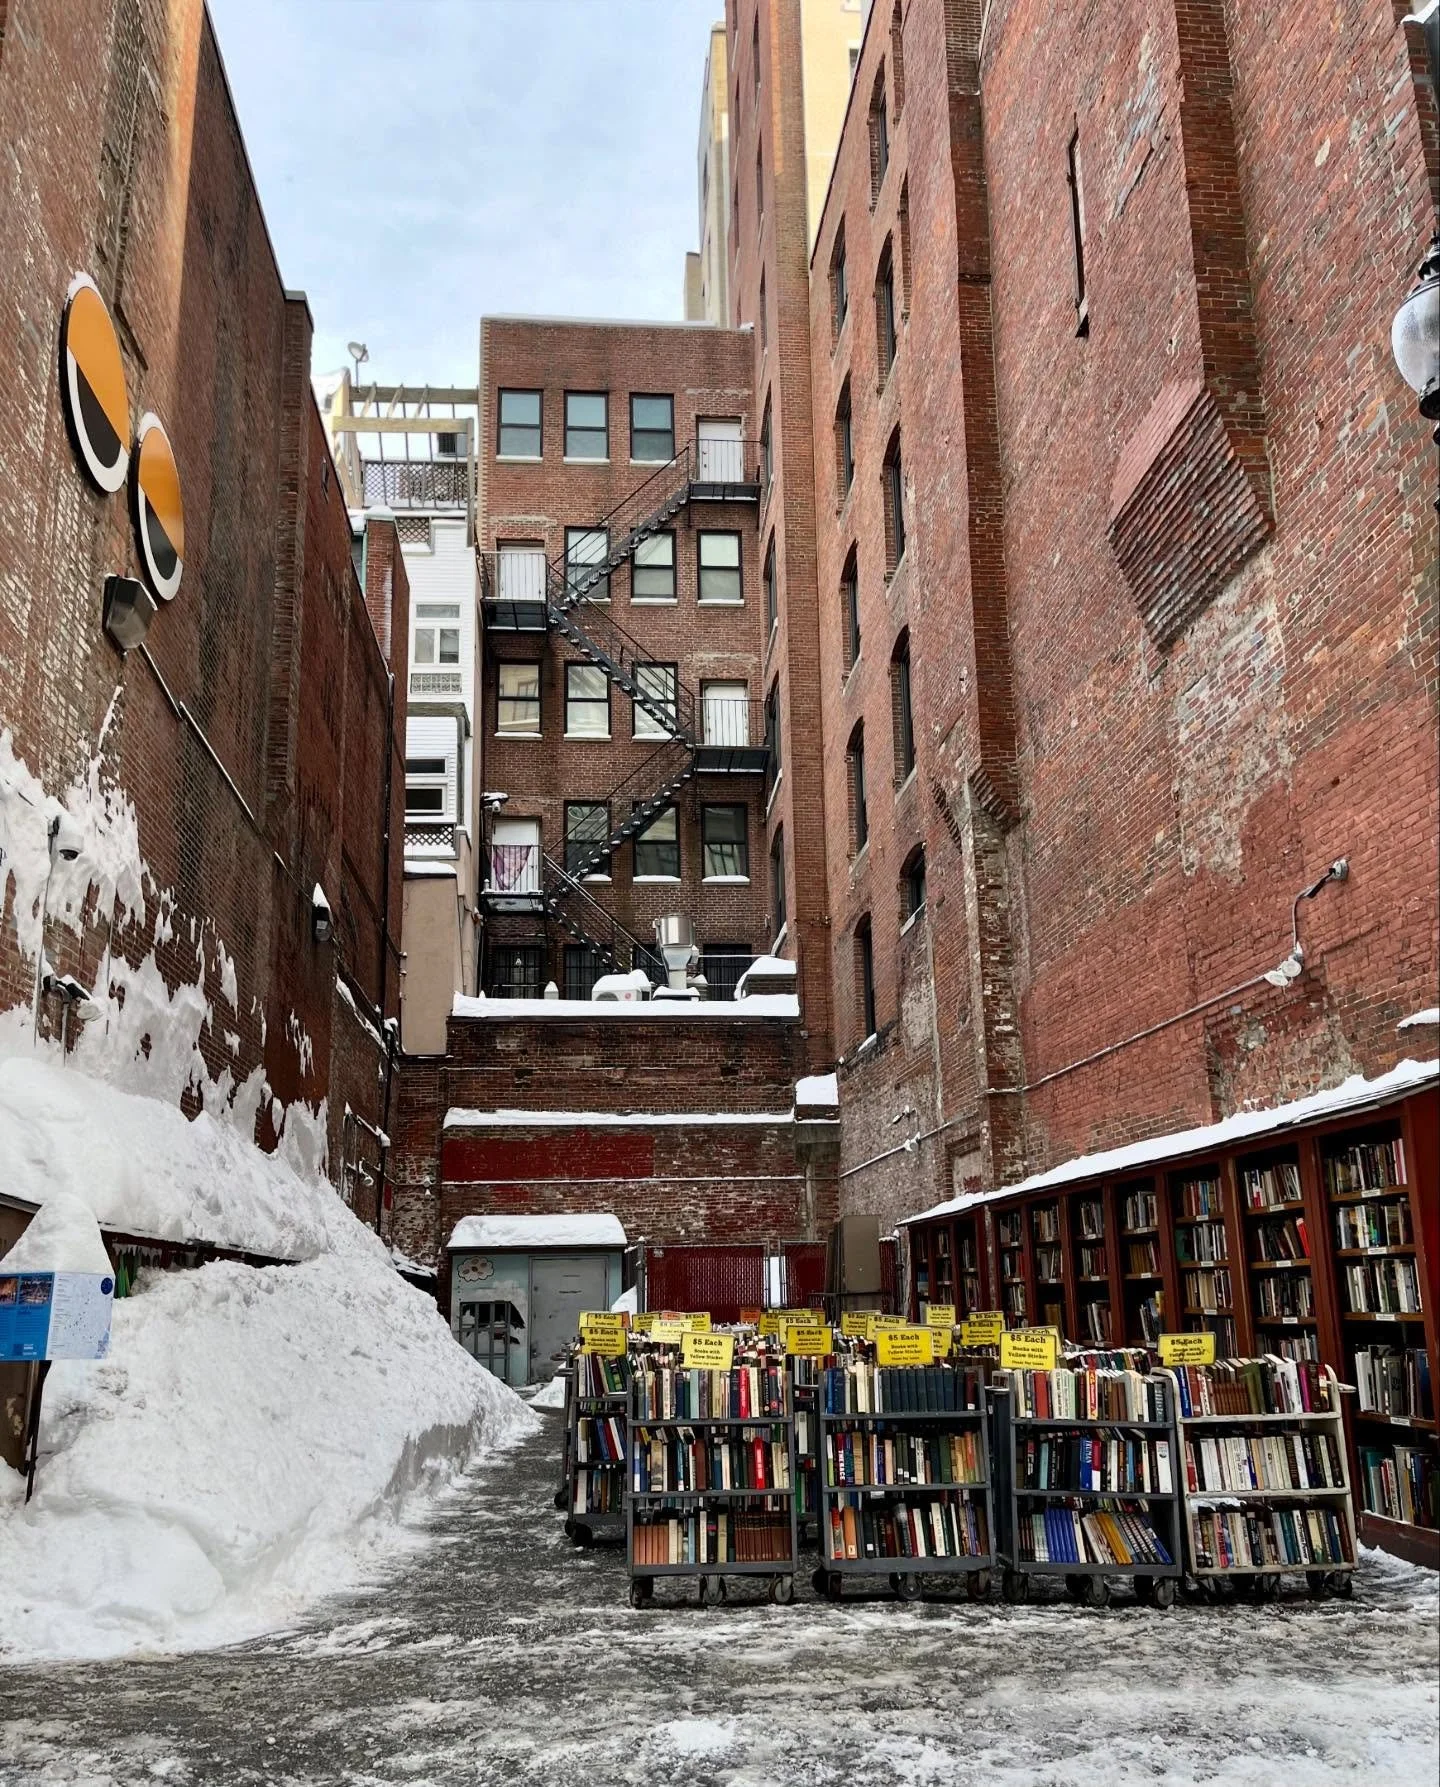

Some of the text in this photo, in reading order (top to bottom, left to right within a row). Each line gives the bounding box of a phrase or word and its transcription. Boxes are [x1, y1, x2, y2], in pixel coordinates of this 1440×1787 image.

[704, 1339, 723, 1347] Each
[1010, 1334, 1046, 1344] $5 Each
